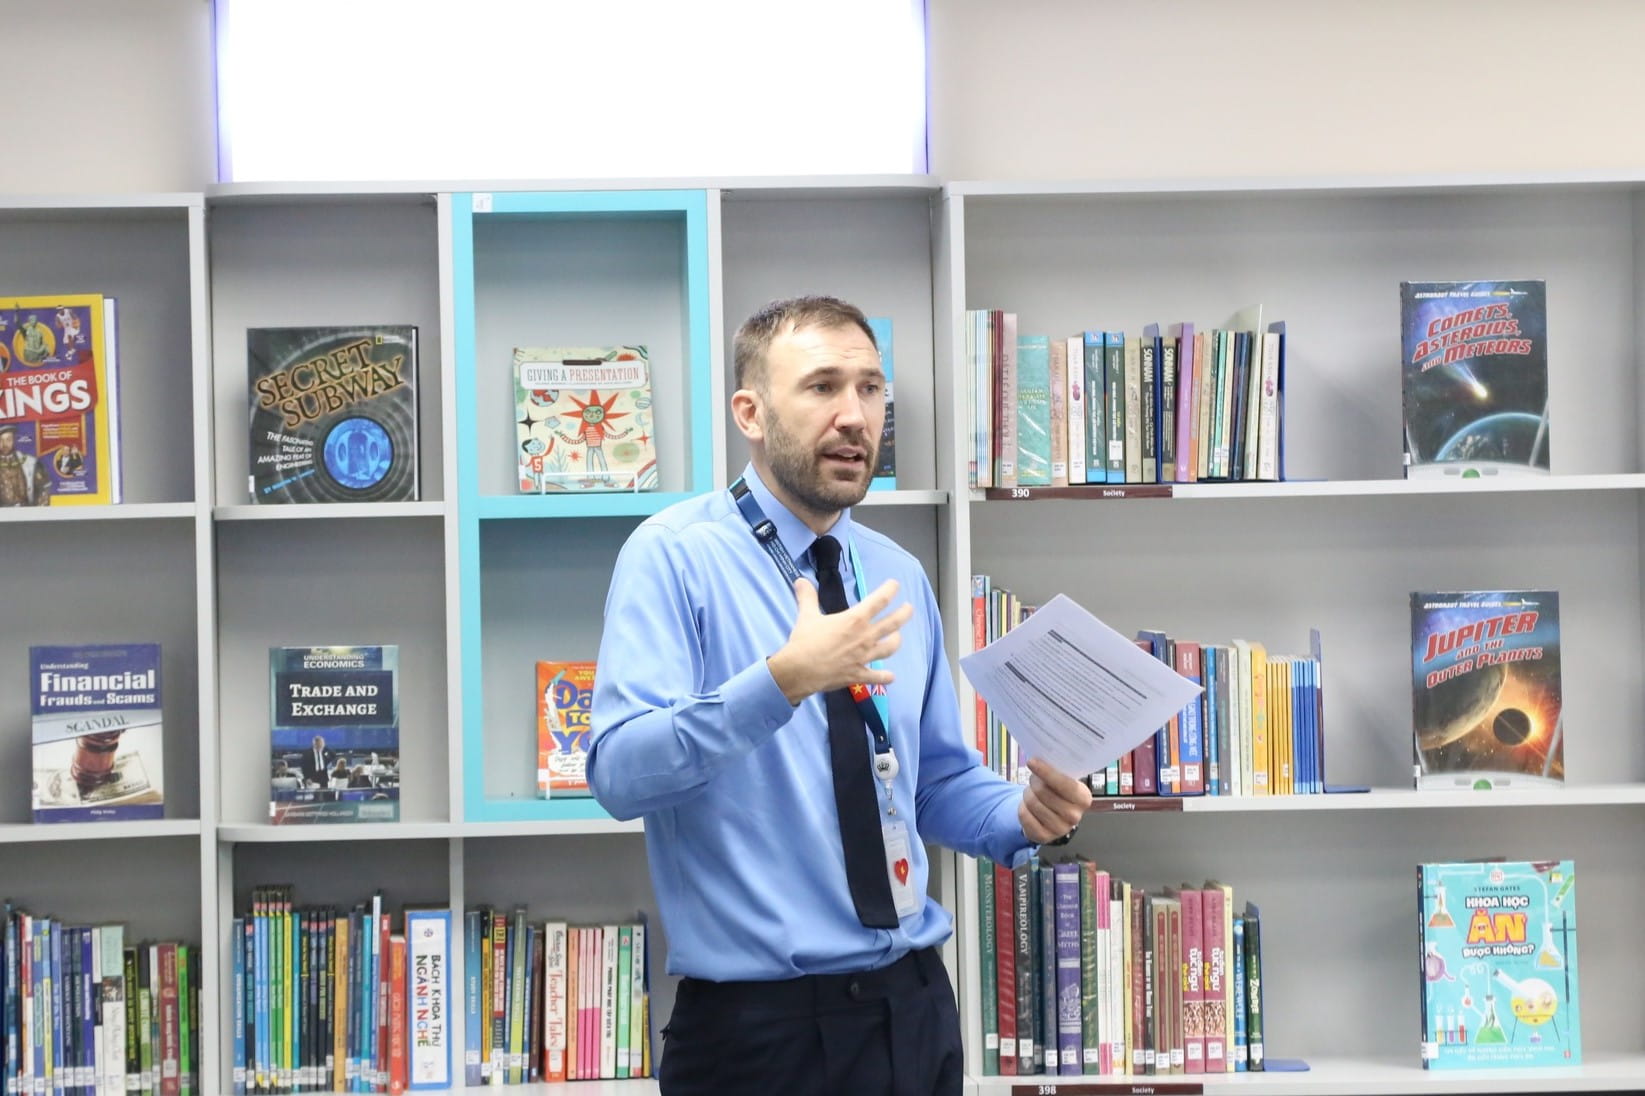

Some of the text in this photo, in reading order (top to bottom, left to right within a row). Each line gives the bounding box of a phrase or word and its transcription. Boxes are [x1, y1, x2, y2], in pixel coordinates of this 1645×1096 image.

[1442, 338, 1532, 366] METEORS
[7, 371, 73, 387] THE BOOK OF
[257, 340, 371, 406] SECRET
[527, 366, 639, 382] GIVING A PRESENTATION
[281, 357, 404, 428] SUBWAY
[267, 432, 282, 442] THE
[257, 454, 292, 464] AMAZING
[1011, 488, 1125, 498] 390 Society
[1423, 611, 1539, 663] JUPITER
[40, 662, 89, 670] Understanding
[304, 661, 365, 669] ECONOMICS
[1427, 647, 1543, 689] OUTER PLANETS
[40, 670, 155, 693] Financial
[289, 683, 378, 698] TRADE AND
[40, 693, 92, 707] Frauds
[106, 693, 155, 705] Scams
[291, 702, 378, 716] EXCHANGE
[66, 715, 130, 733] SCANDAL
[1113, 802, 1136, 811] Society
[1466, 895, 1529, 911] KHOA HỌC
[984, 874, 994, 954] MONSTEROLOGY
[1019, 874, 1029, 955] VAMPIREOLOGY
[1492, 943, 1536, 957] KHÔNG?
[431, 989, 442, 1022] KHOA
[550, 969, 564, 1048] Teacher Tales
[1038, 1085, 1155, 1096] 398 Society
